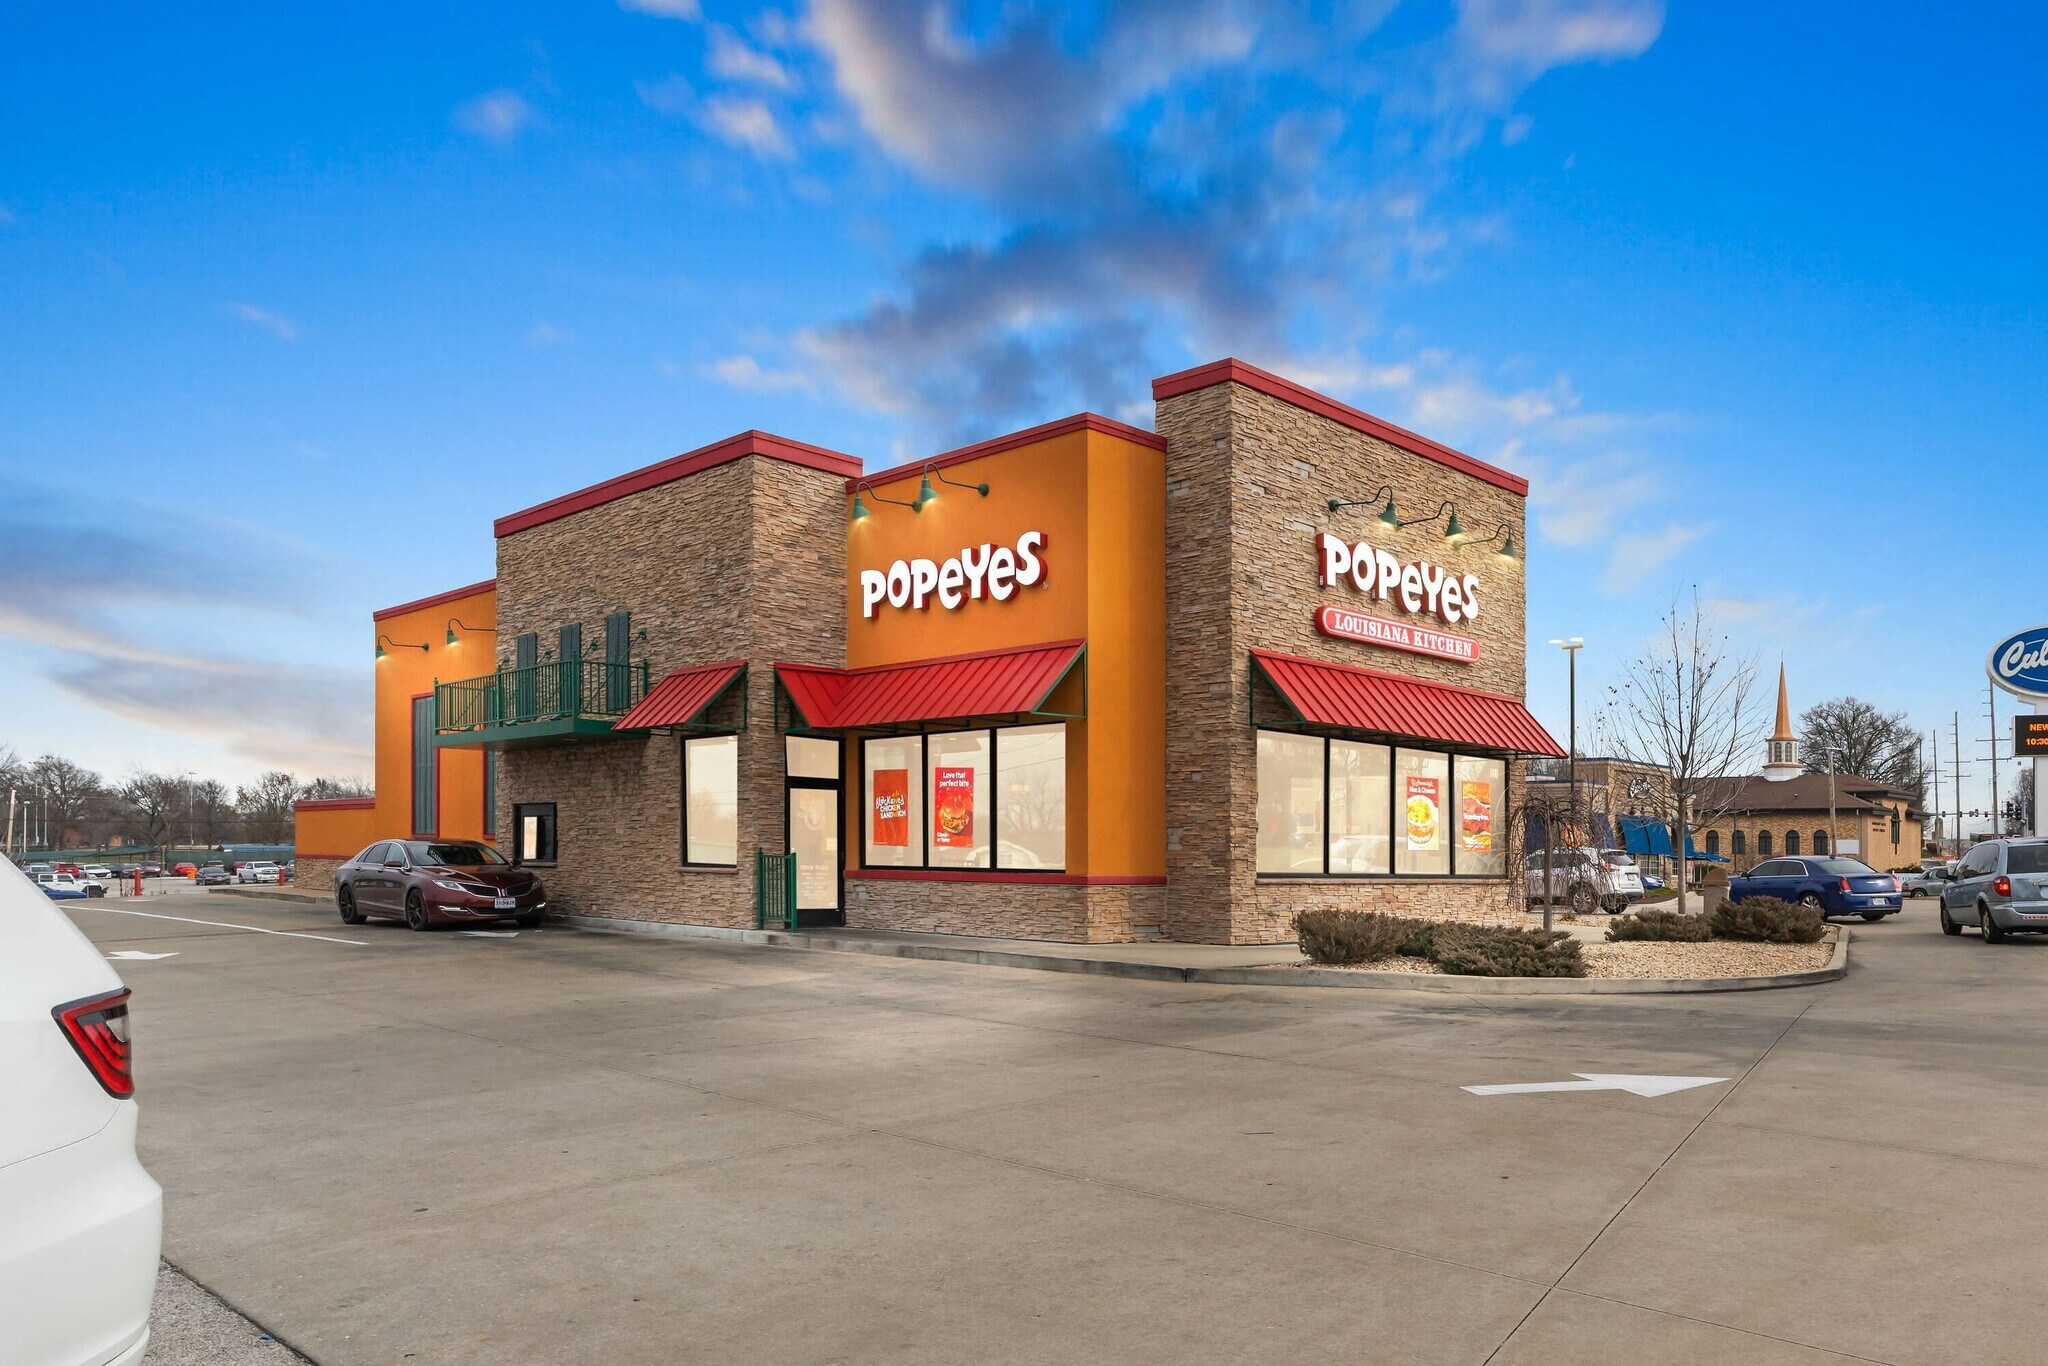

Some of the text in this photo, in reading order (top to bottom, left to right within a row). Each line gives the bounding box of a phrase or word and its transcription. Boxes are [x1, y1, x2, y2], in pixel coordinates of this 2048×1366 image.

[1334, 612, 1472, 657] LOUISIANA KITCHEN
[956, 771, 966, 779] that
[939, 780, 958, 788] perfect
[880, 804, 900, 812] CHICKEN
[880, 810, 906, 819] SANDWICH
